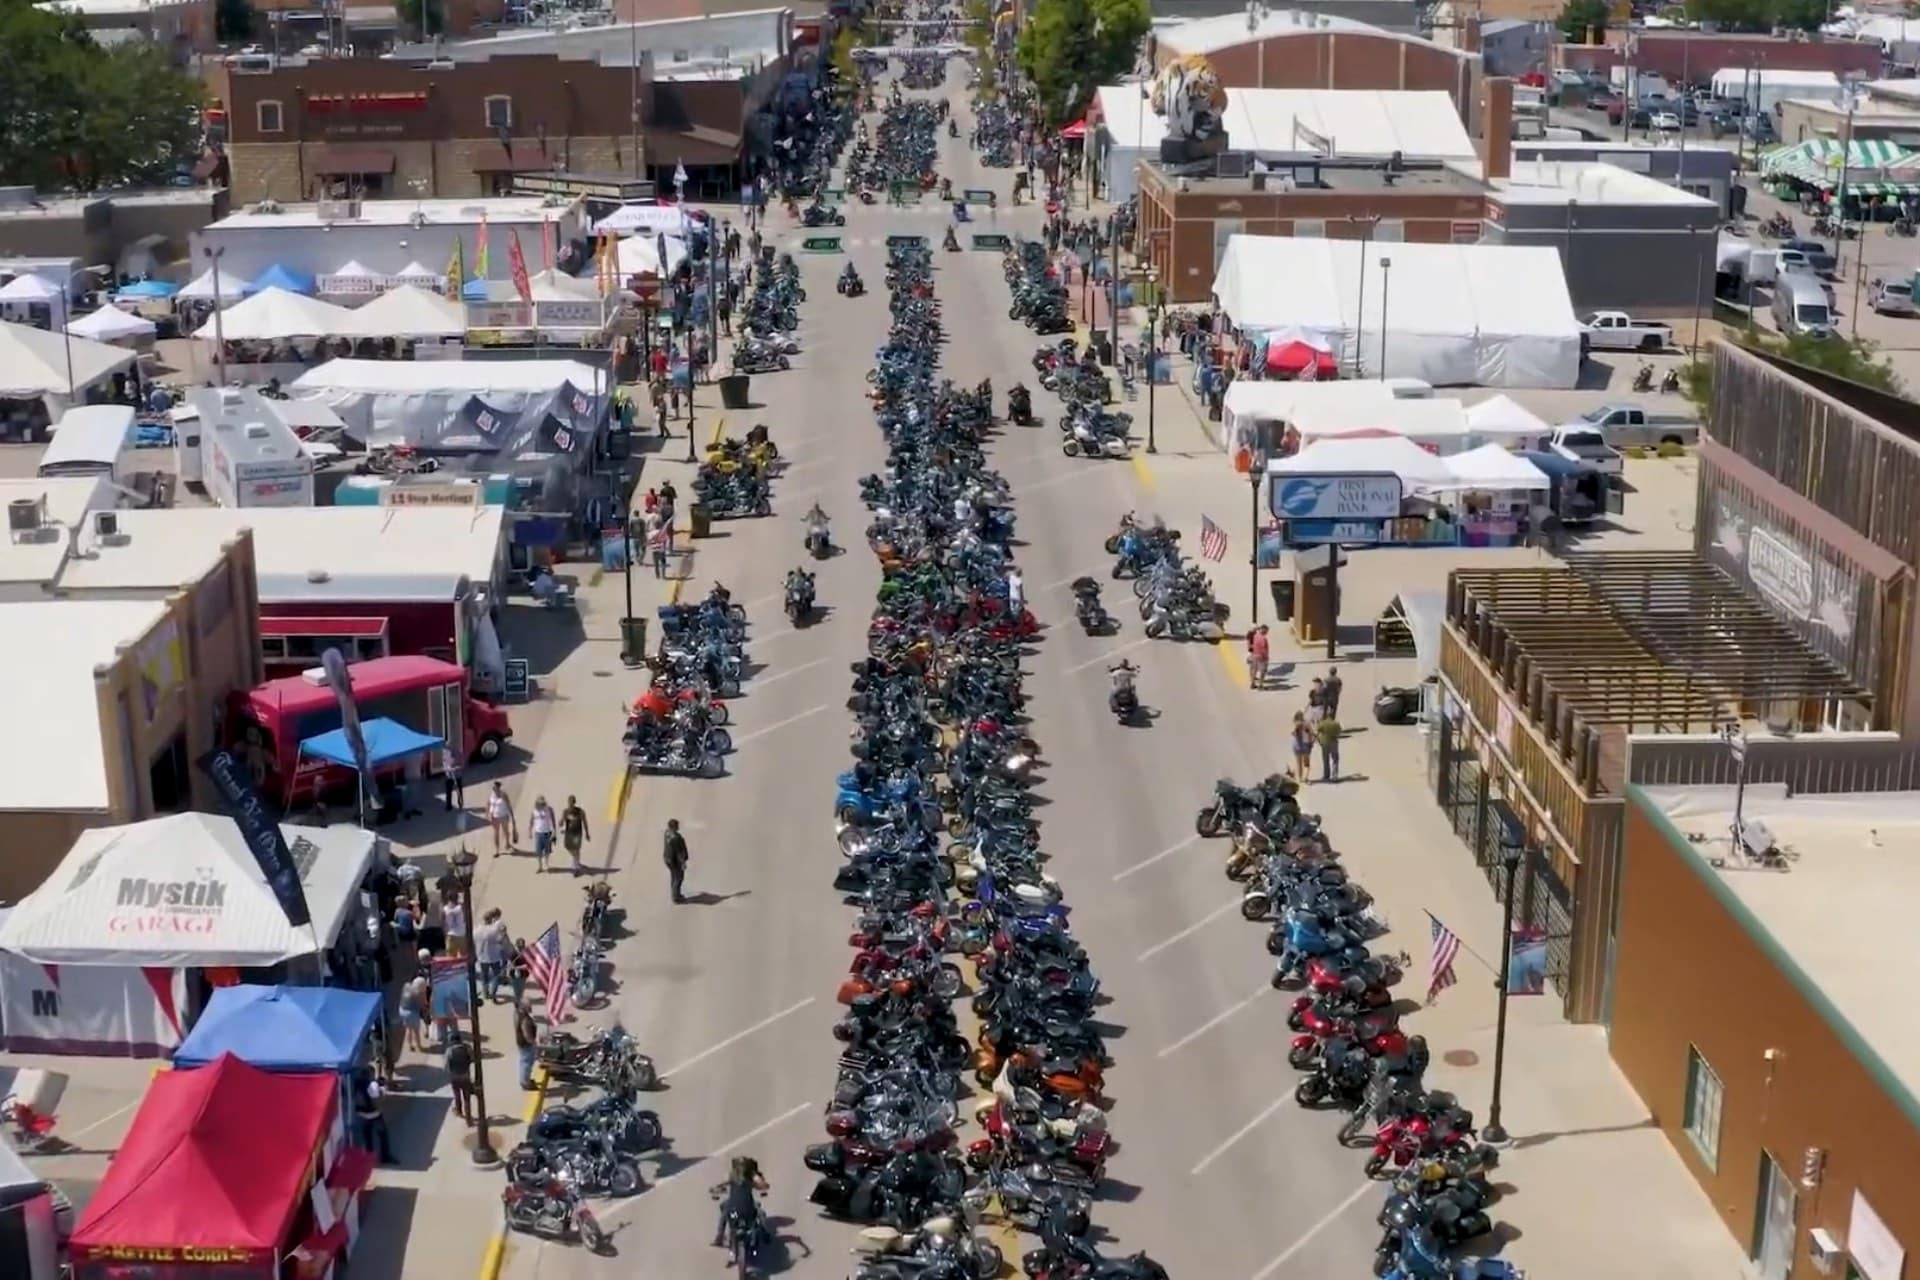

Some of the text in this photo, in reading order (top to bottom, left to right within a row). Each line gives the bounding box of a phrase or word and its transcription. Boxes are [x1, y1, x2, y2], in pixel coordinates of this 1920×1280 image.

[1338, 480, 1365, 489] FIRST
[431, 493, 473, 505] Meetings
[1338, 491, 1394, 501] NATIONAL
[1338, 503, 1368, 513] BANK
[117, 877, 227, 908] Mystik
